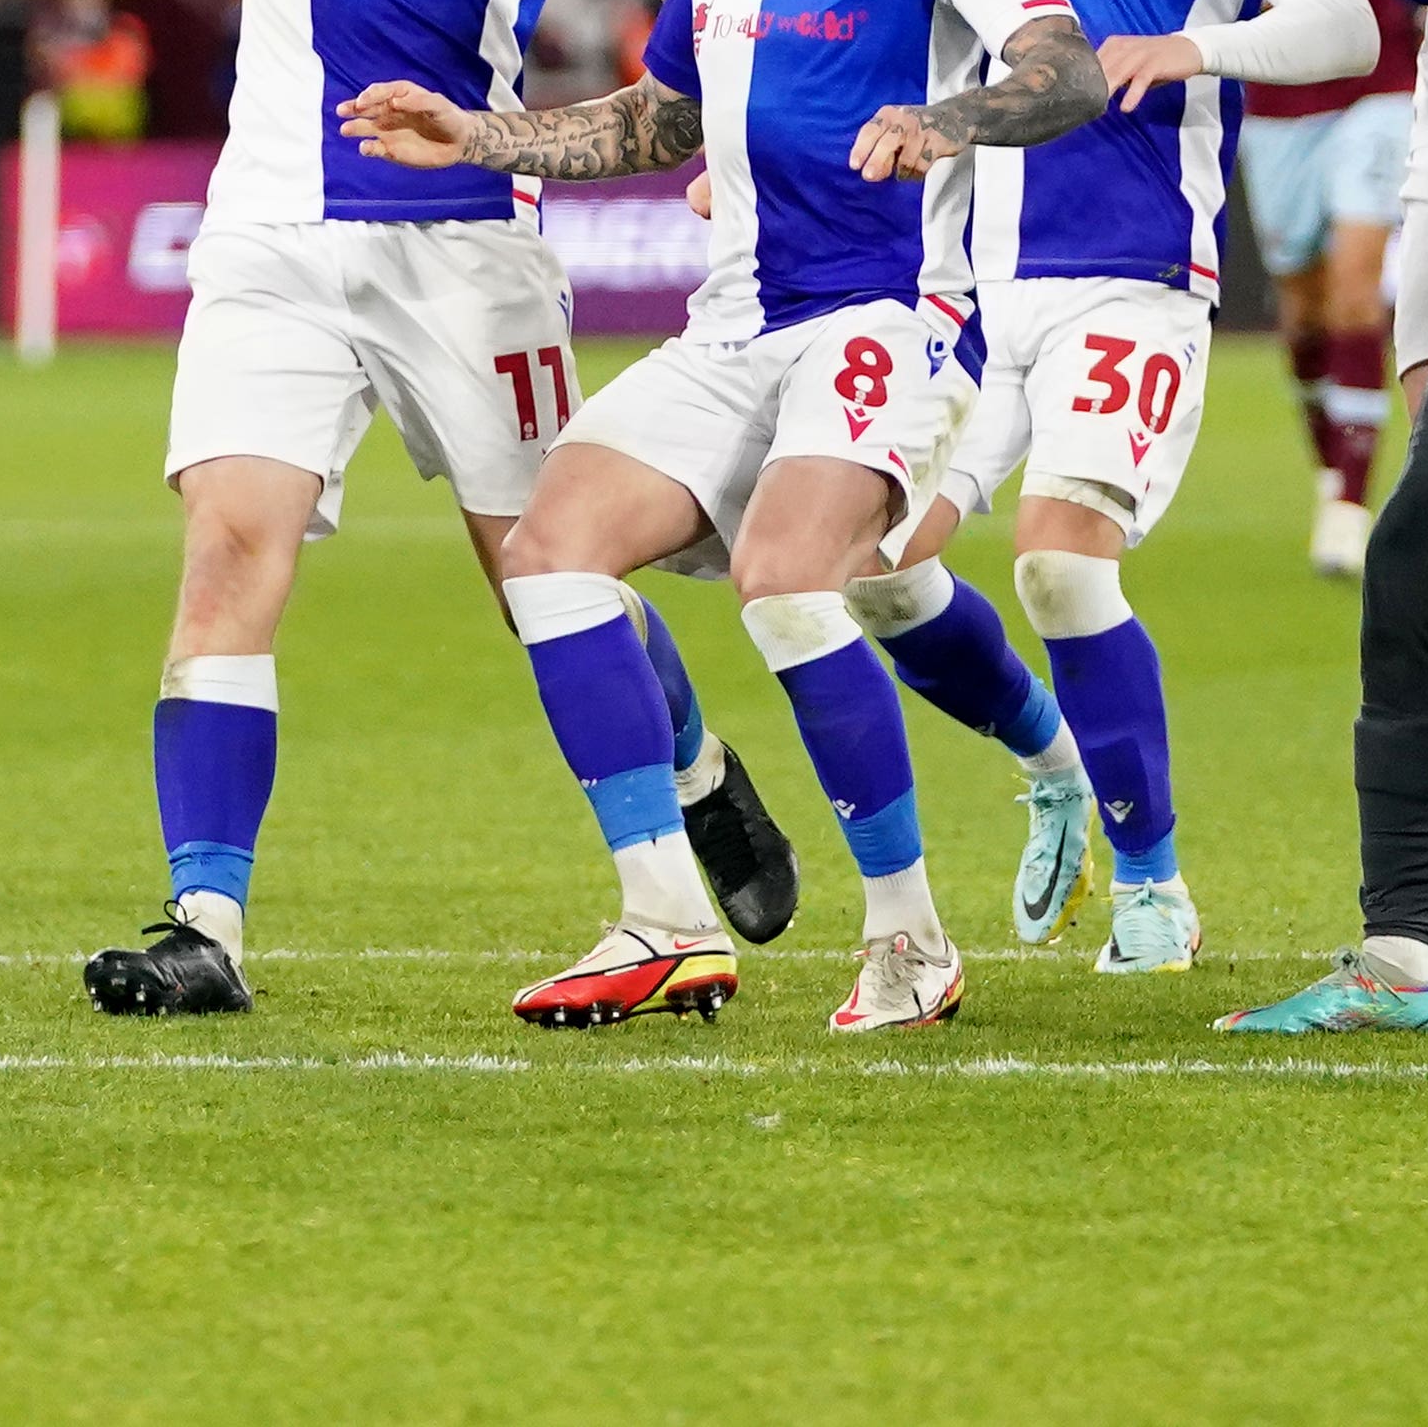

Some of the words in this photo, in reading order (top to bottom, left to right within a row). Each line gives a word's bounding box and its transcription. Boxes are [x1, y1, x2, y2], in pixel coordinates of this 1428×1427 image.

[494, 345, 571, 441] 11
[834, 336, 893, 407] 8
[1071, 333, 1181, 434] 30
